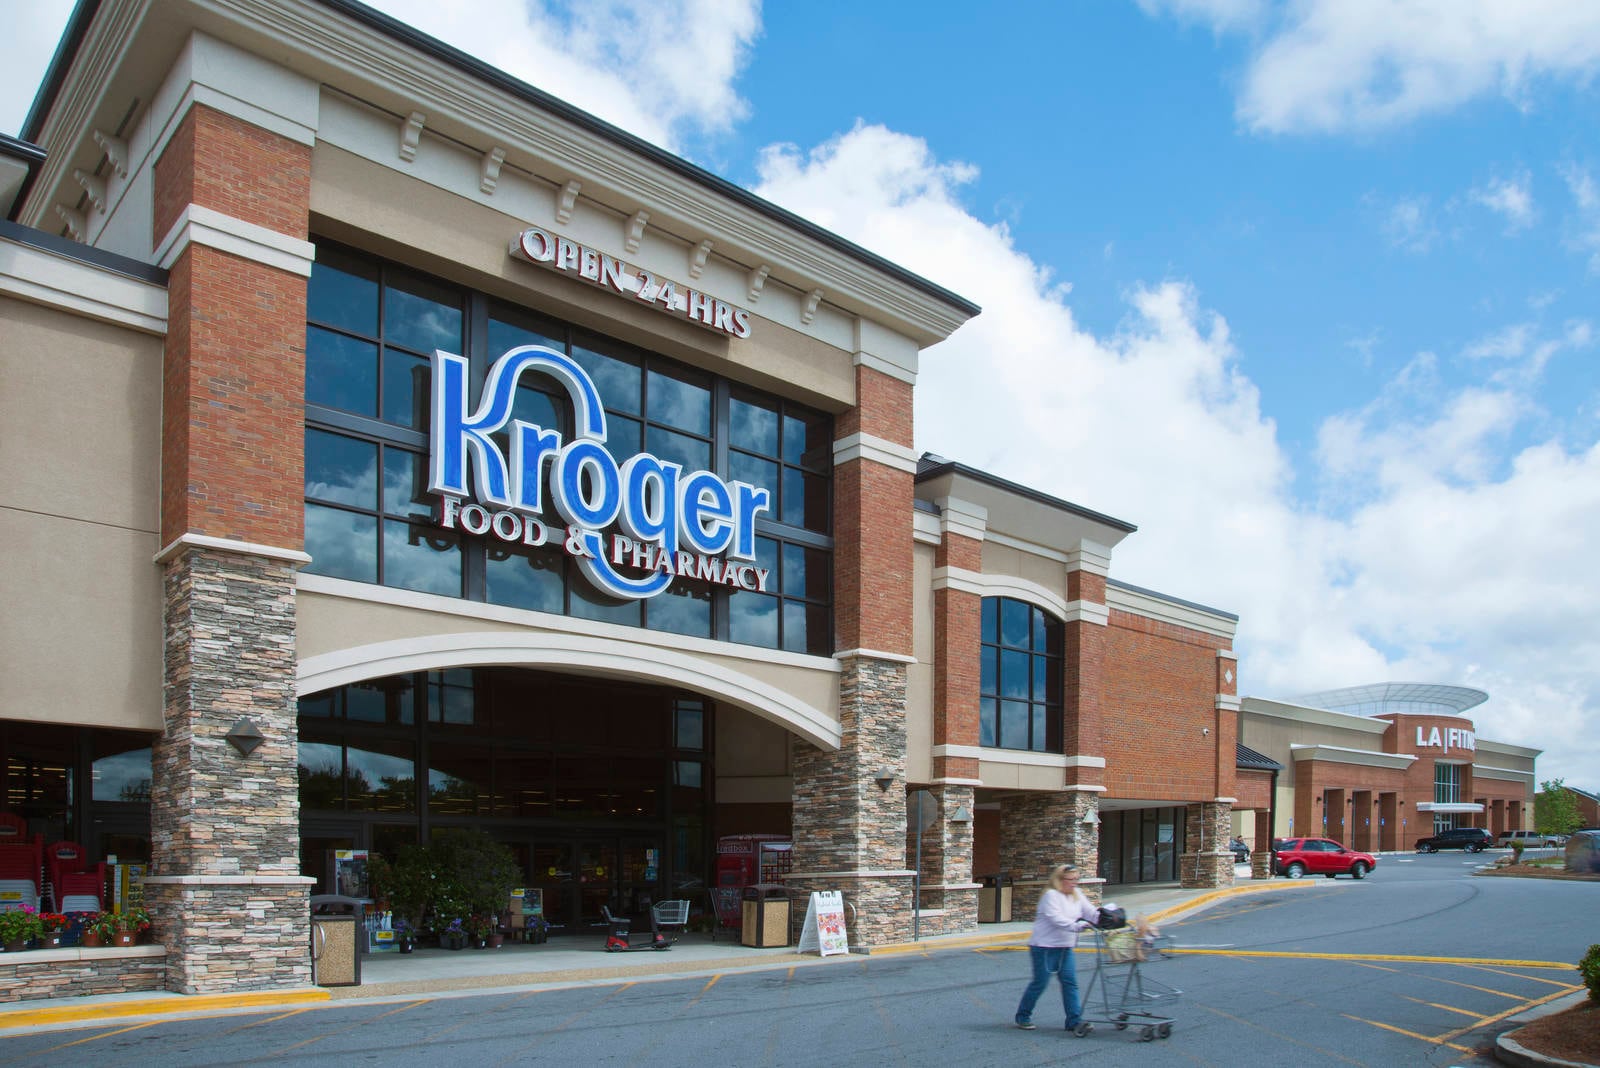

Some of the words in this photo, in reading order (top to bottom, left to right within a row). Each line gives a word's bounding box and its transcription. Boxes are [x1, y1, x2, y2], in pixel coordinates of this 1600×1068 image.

[519, 227, 625, 293] OPEN
[635, 271, 676, 311] 24
[687, 289, 751, 339] HRS
[427, 344, 770, 599] Kroger
[441, 494, 549, 547] FOOD
[563, 524, 597, 559] &
[611, 534, 770, 592] PHARMACY
[1416, 726, 1442, 747] LA
